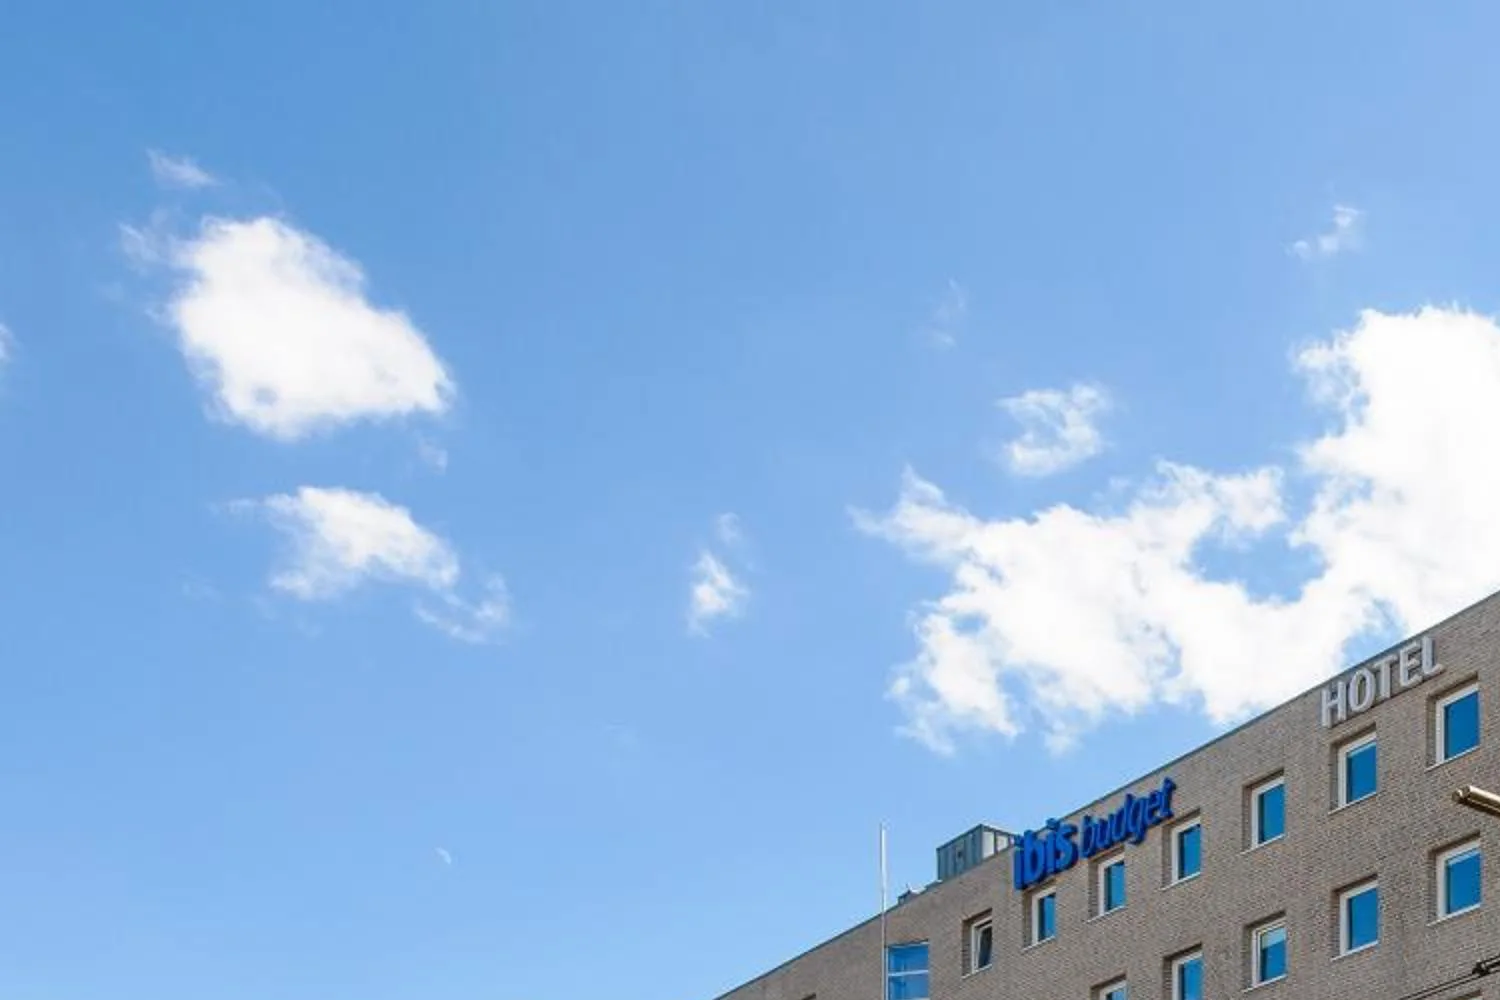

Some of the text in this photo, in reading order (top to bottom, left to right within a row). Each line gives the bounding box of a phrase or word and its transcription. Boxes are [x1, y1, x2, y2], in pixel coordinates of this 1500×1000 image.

[1321, 635, 1444, 729] HOTEL
[1013, 776, 1177, 890] ibis budget
